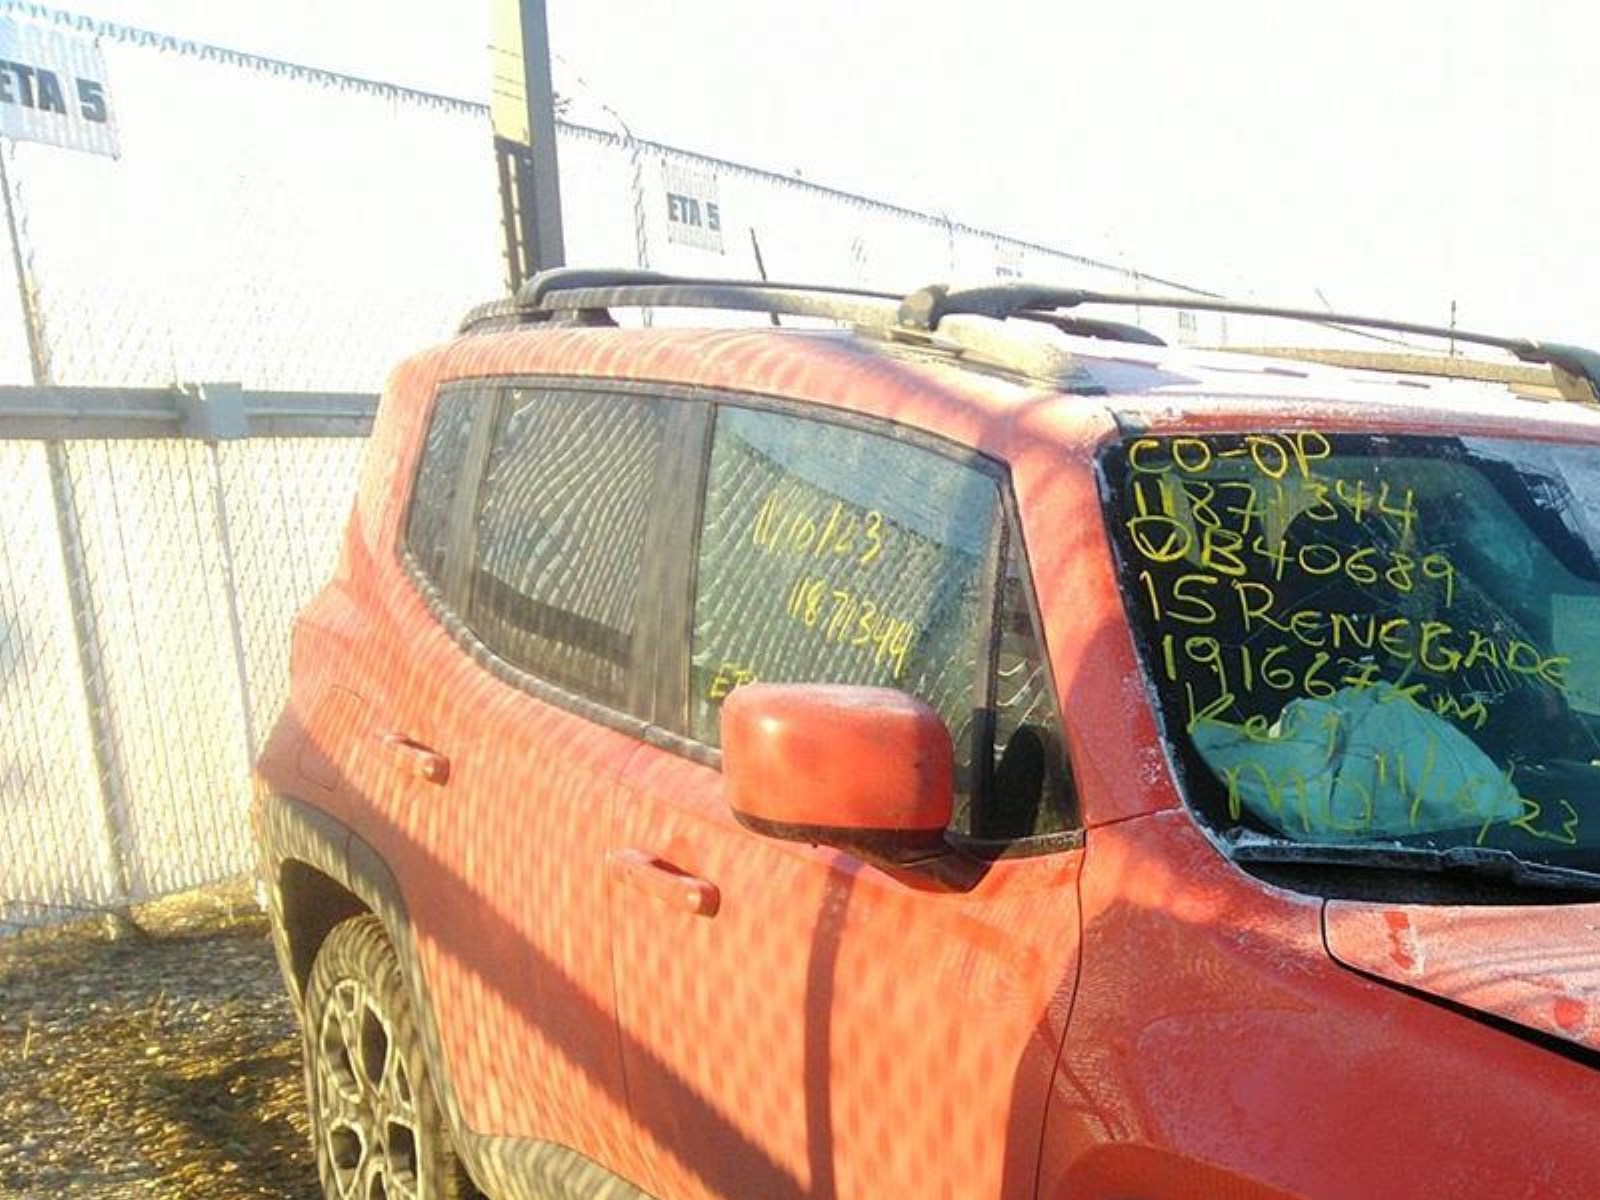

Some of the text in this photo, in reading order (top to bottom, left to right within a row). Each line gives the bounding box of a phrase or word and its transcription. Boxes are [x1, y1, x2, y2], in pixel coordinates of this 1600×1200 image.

[75, 77, 108, 124] 5
[667, 192, 721, 232] ETA 5
[1127, 430, 1332, 480] CO-OP
[1132, 478, 1418, 550] 11871344
